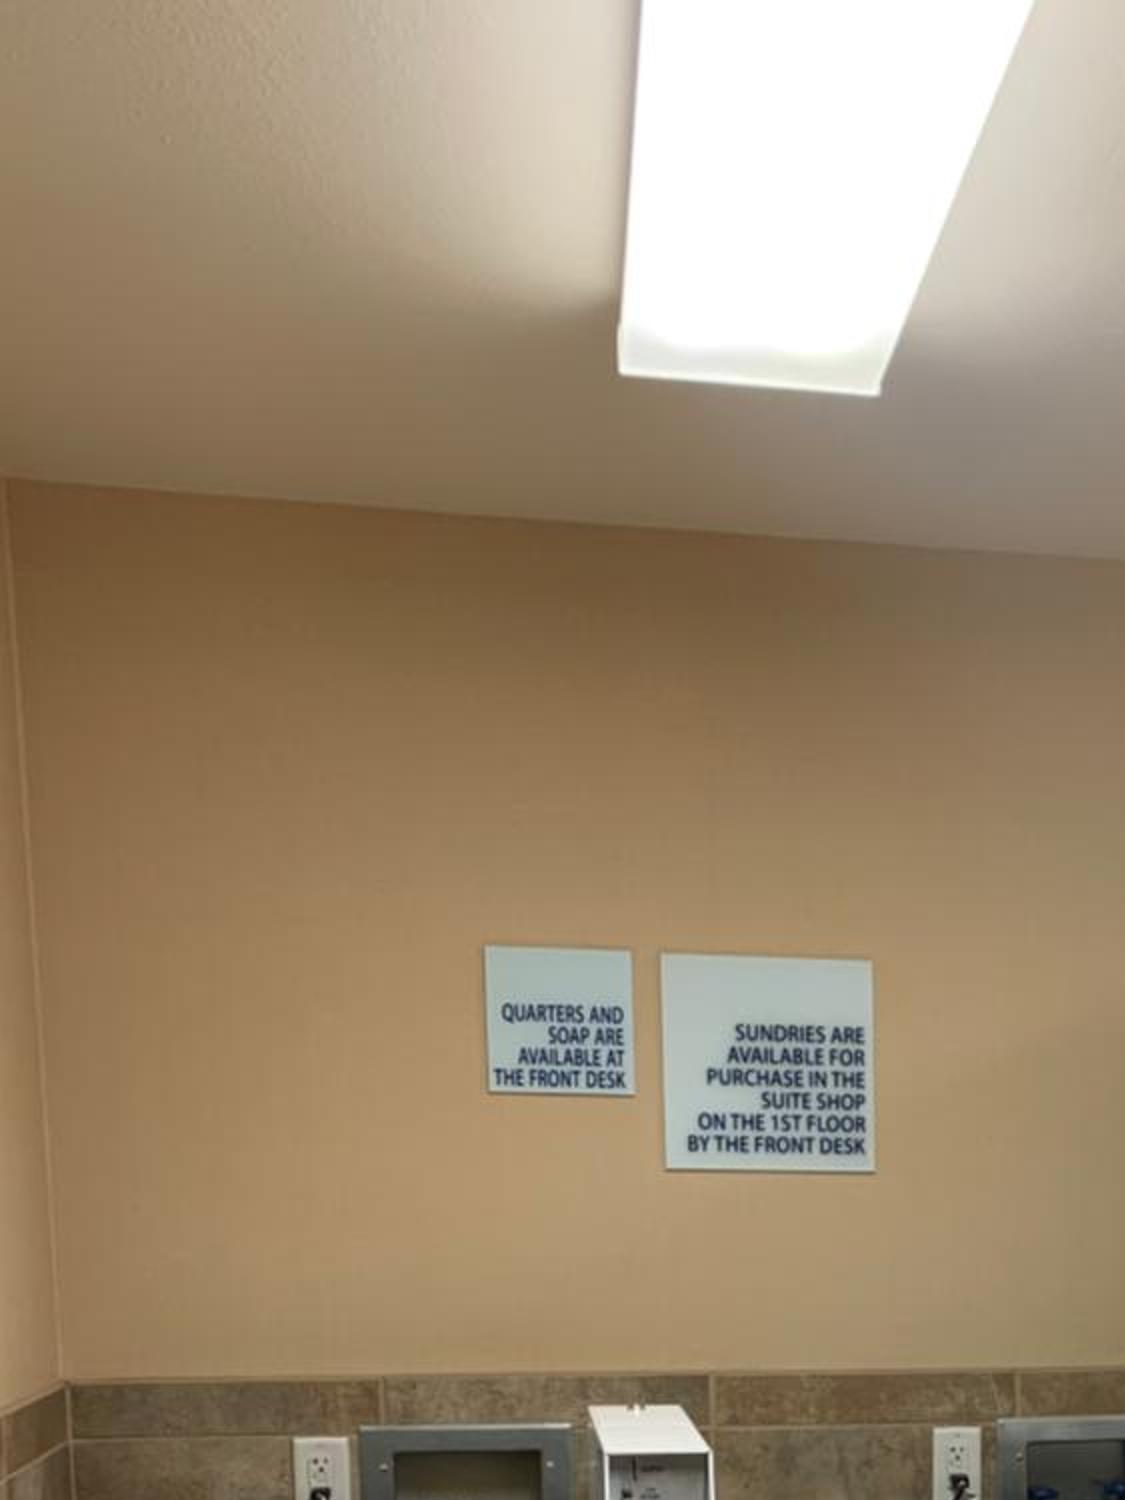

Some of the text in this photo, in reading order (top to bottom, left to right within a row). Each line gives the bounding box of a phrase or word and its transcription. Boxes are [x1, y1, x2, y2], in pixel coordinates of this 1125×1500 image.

[501, 1003, 625, 1025] QUARTERS AND
[548, 1026, 624, 1046] SOAP ARE
[735, 1023, 865, 1044] SUNDRIES ARE
[518, 1047, 624, 1067] AVAILABLE AT
[727, 1046, 865, 1067] AVAILABLE FOR
[494, 1068, 626, 1089] THE FRONT DESK
[707, 1068, 865, 1089] PURCHASE IN THE
[761, 1091, 866, 1111] SUITE SHOP
[698, 1112, 867, 1134] ON THE 1ST FLOOR
[687, 1134, 866, 1155] BY THE FRONT DESK
